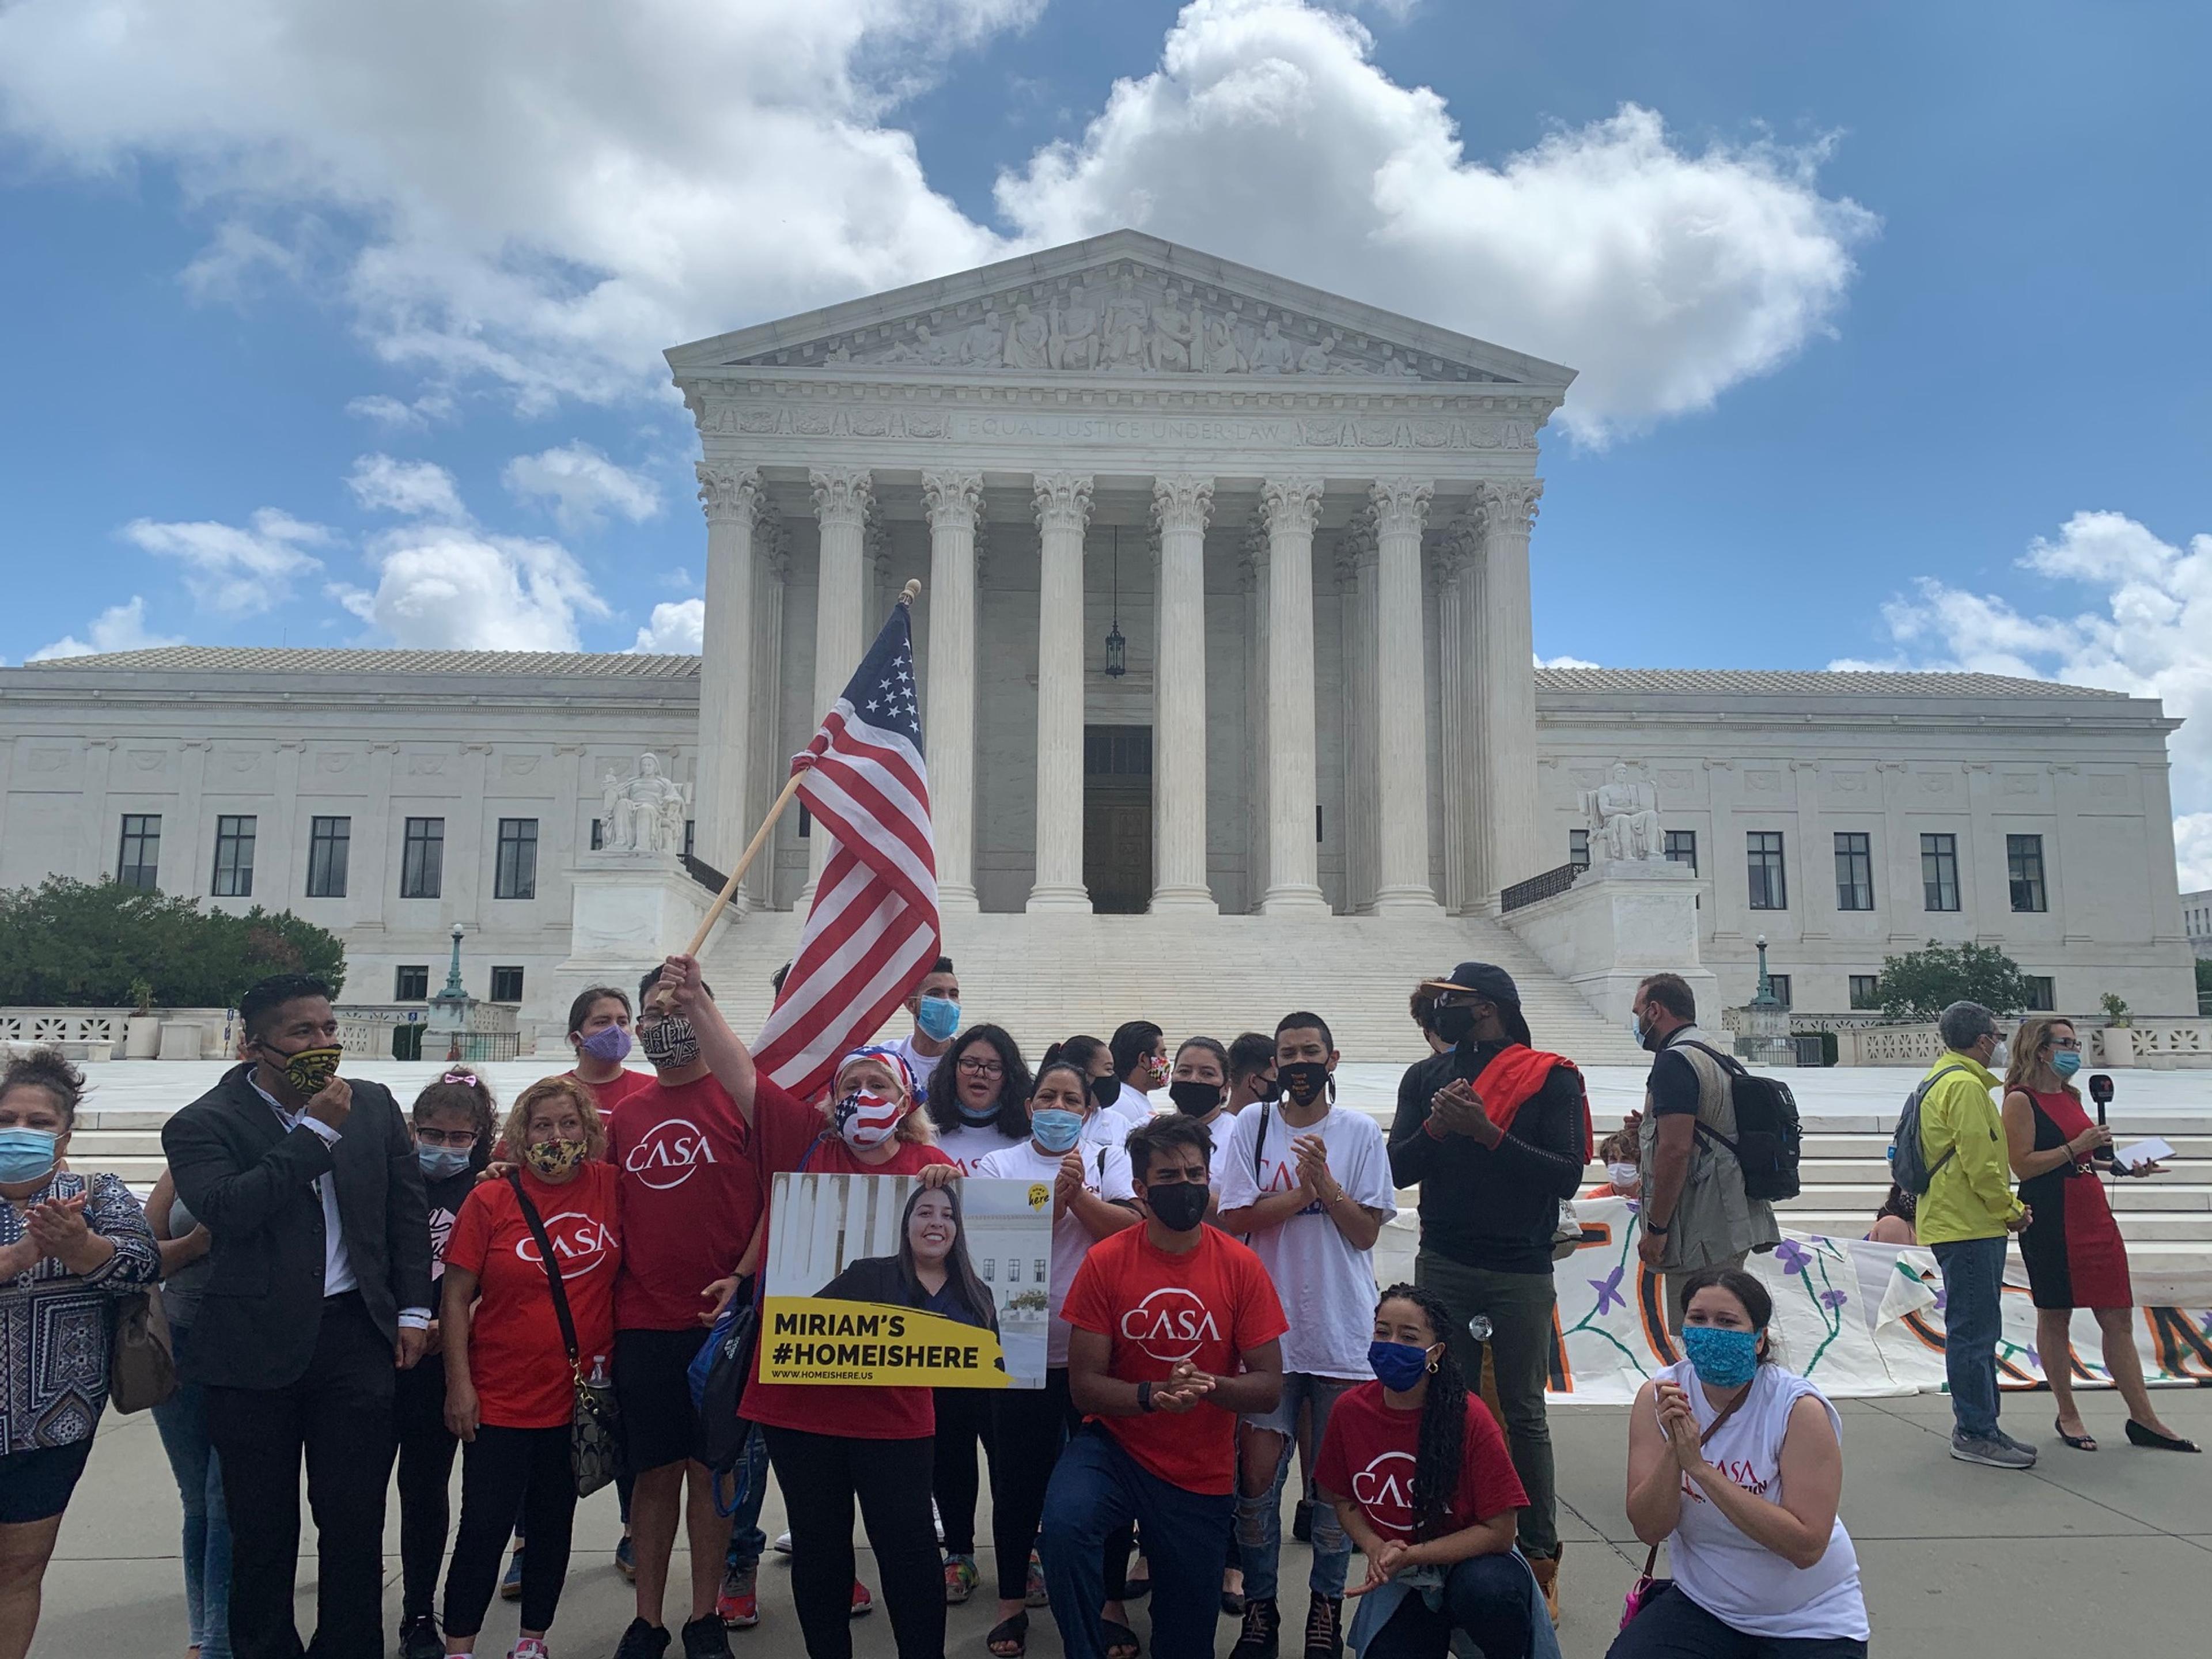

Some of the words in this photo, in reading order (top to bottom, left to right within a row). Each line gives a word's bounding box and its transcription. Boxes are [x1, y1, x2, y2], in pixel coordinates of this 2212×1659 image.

[968, 418, 1045, 437] EQUAL
[1052, 421, 1141, 438] JUSTICE
[1152, 423, 1229, 440] UNDER
[1235, 424, 1279, 440] LAW
[626, 1135, 718, 1172] CASA
[1028, 1194, 1050, 1206] here
[516, 1223, 619, 1259] CASA
[774, 1313, 905, 1338] MIRIAM'S
[1120, 1309, 1222, 1341] CASA
[772, 1342, 979, 1369] #HOMEISHERE
[771, 1369, 873, 1380] WWW.HOMEISHERE.US
[1705, 1459, 1758, 1483] ASA
